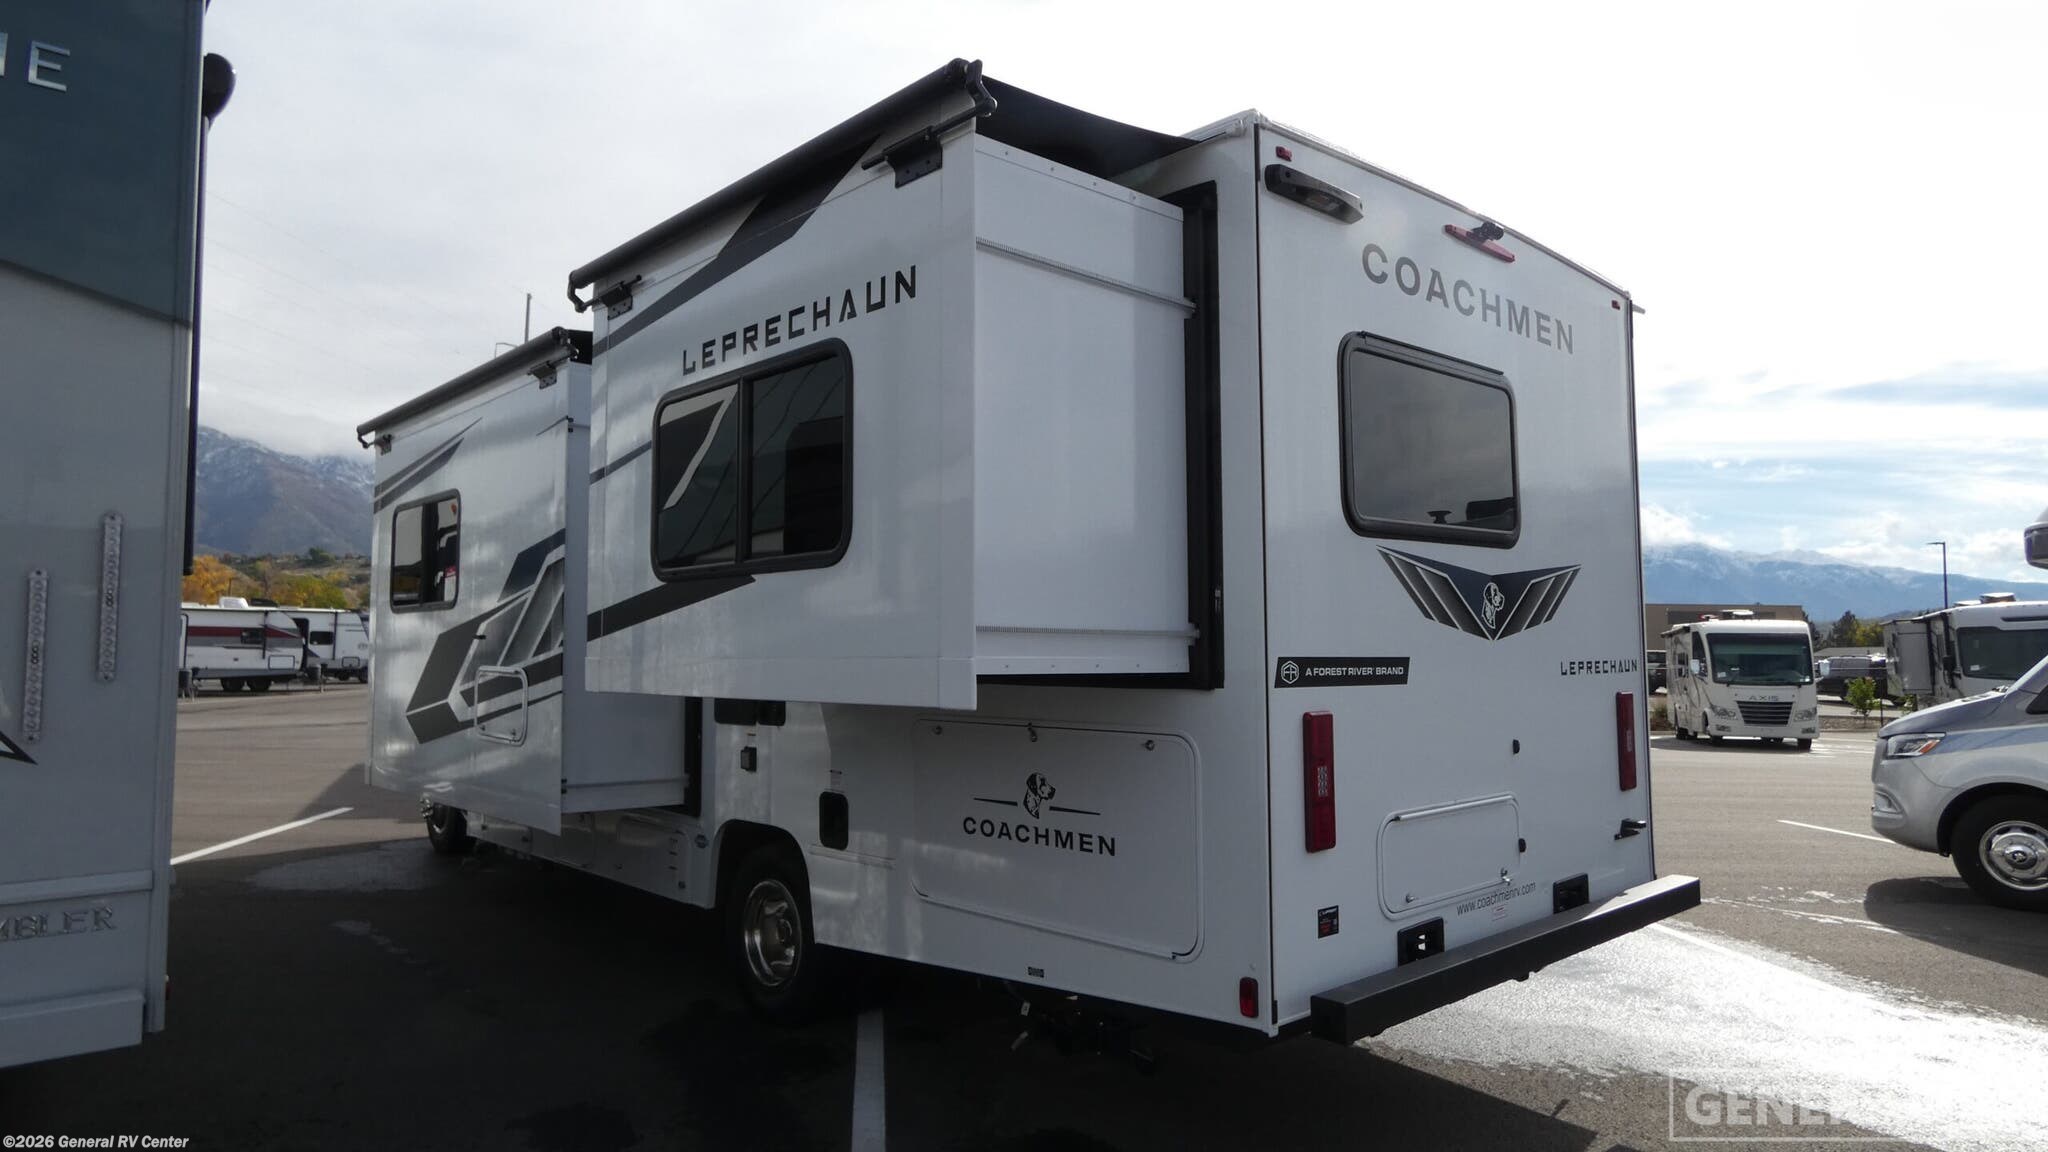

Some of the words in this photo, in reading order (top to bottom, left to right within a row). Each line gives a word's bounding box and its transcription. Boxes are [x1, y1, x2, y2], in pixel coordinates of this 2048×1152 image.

[1361, 243, 1574, 355] COACHMEN
[682, 264, 916, 376] LEPRECHAUN
[1313, 667, 1348, 677] FOREST
[1375, 666, 1404, 676] BRAND
[1560, 659, 1638, 676] LEPRECHAUN
[962, 816, 1116, 857] COACHMEN
[1456, 882, 1536, 916] www.coachmenrv.com
